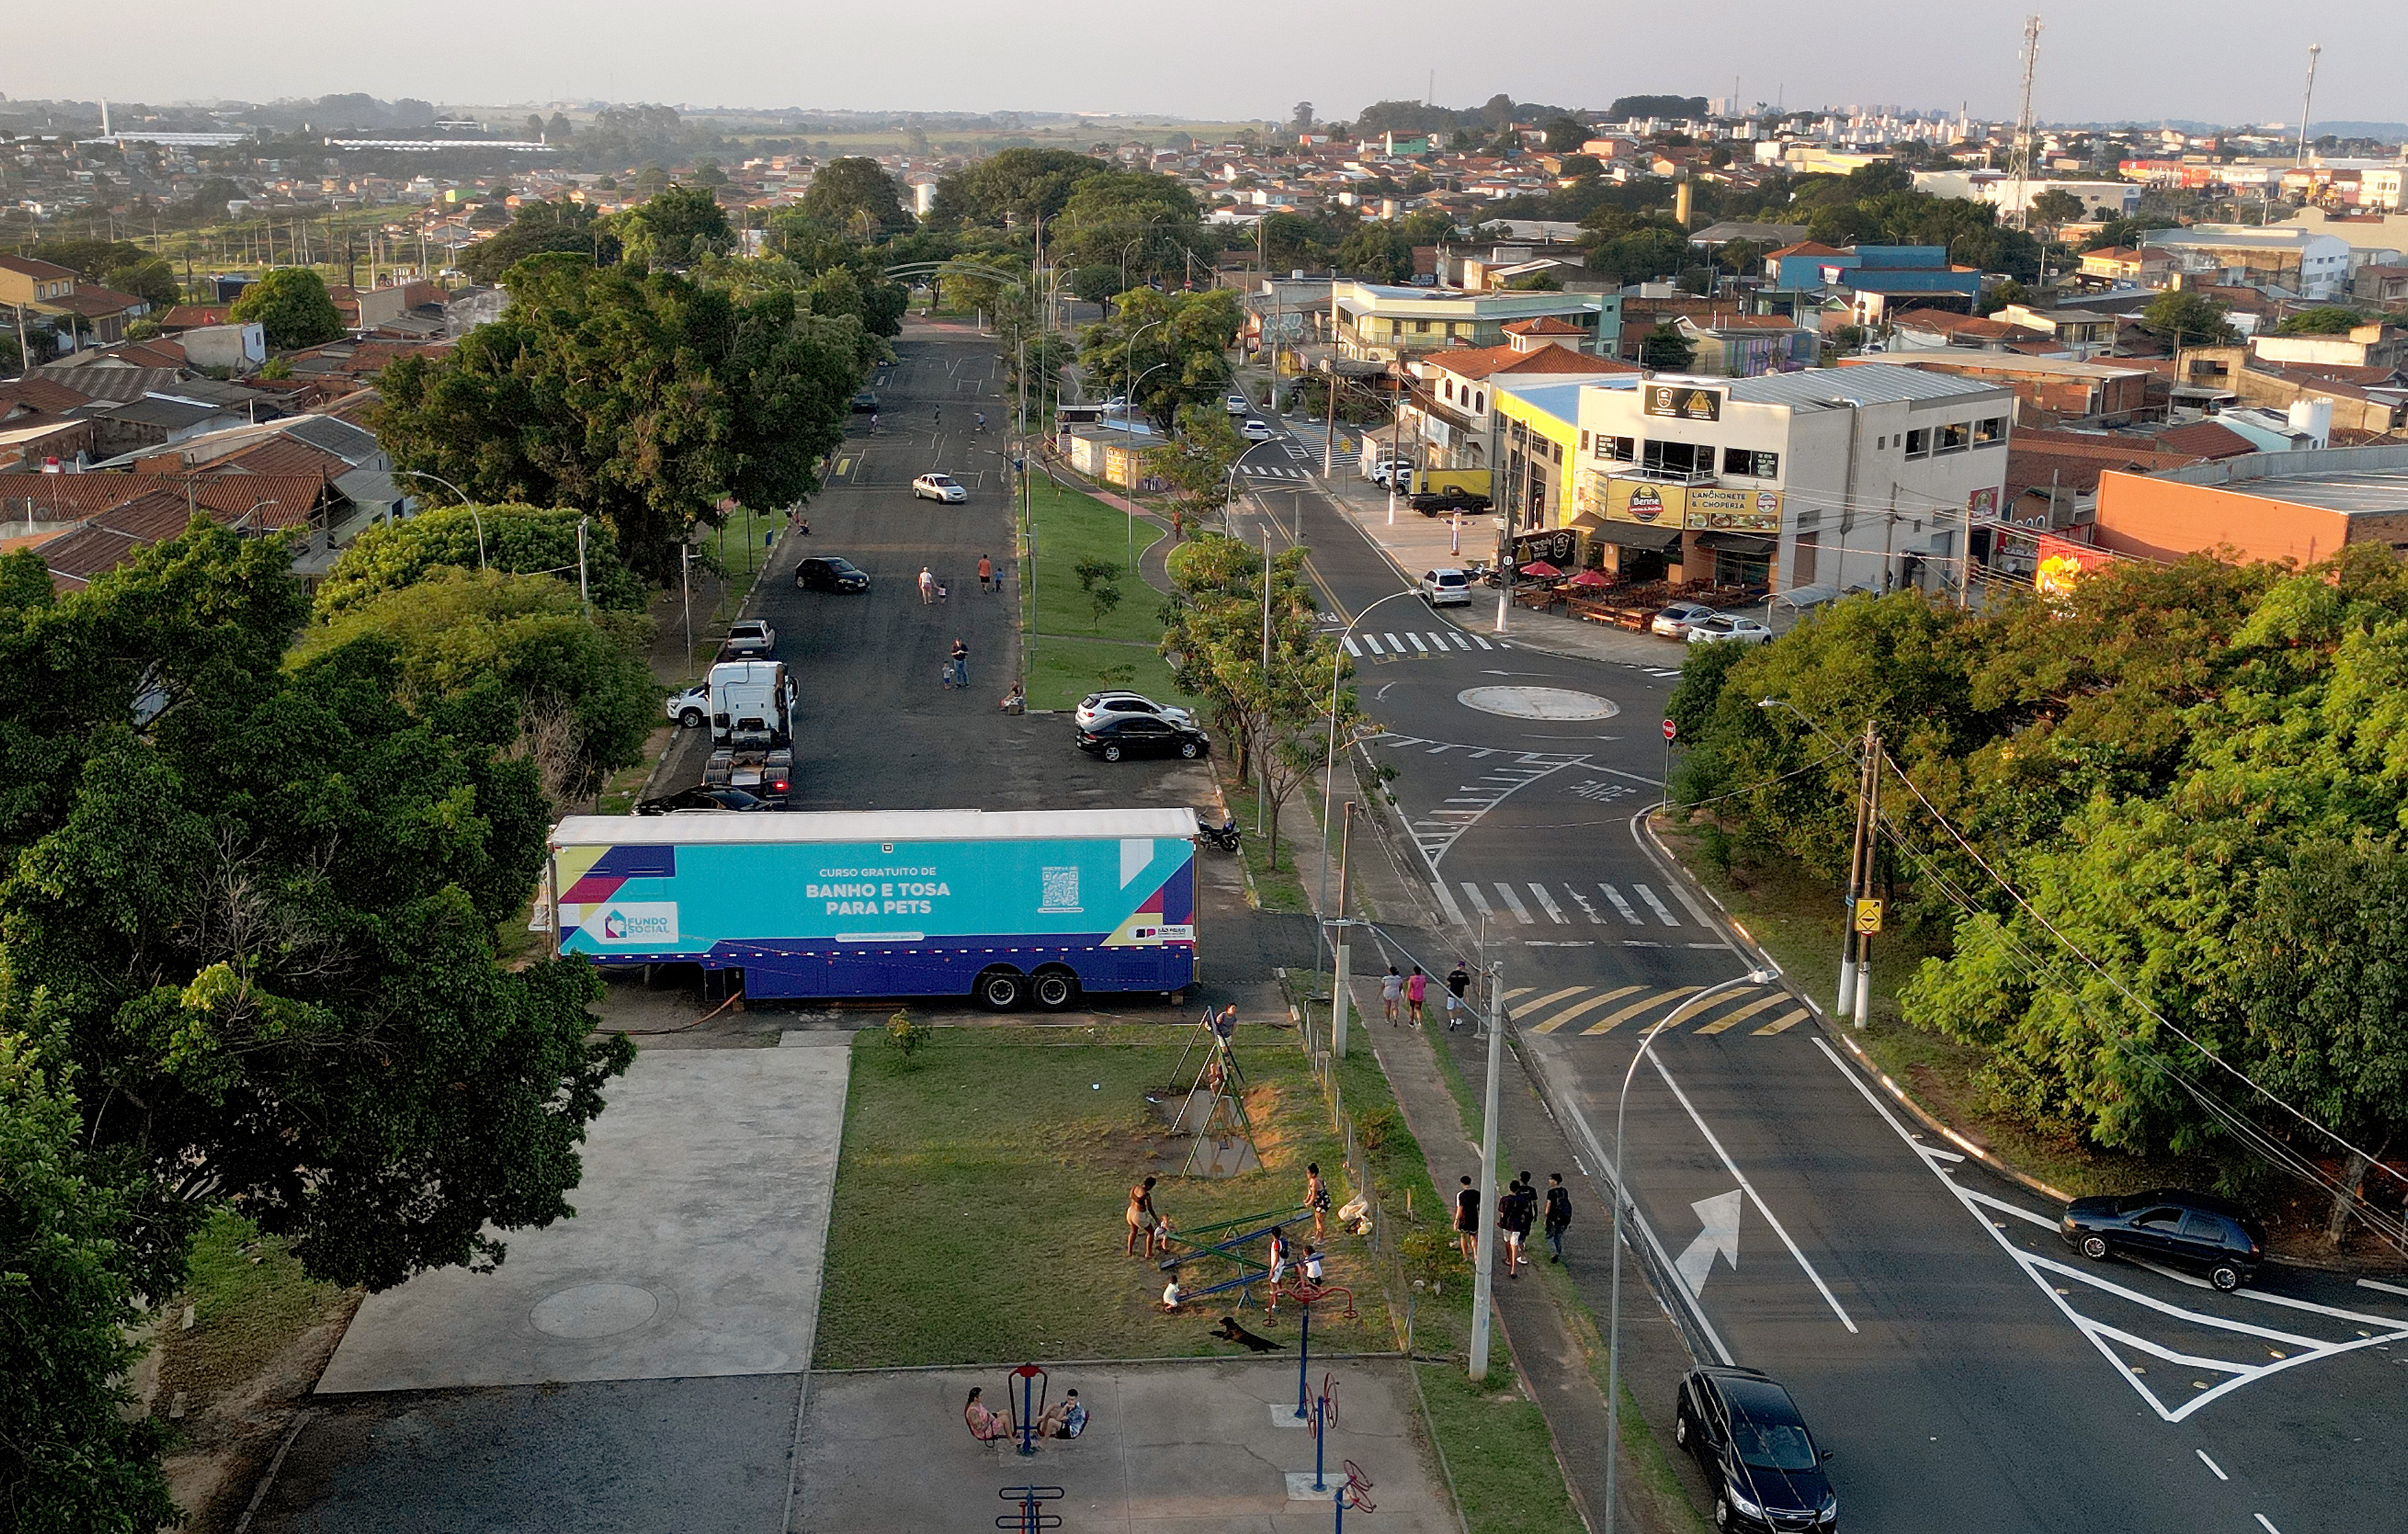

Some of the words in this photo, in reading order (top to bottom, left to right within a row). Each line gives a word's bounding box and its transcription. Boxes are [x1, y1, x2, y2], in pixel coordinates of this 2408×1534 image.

[819, 868, 858, 877] CURSO
[861, 867, 918, 876] GRATUITO
[921, 867, 937, 876] DE
[806, 884, 876, 898] BANHO
[881, 883, 893, 897] E
[898, 882, 951, 896] TOSA
[826, 901, 879, 915] PARA
[884, 900, 932, 914] PETS
